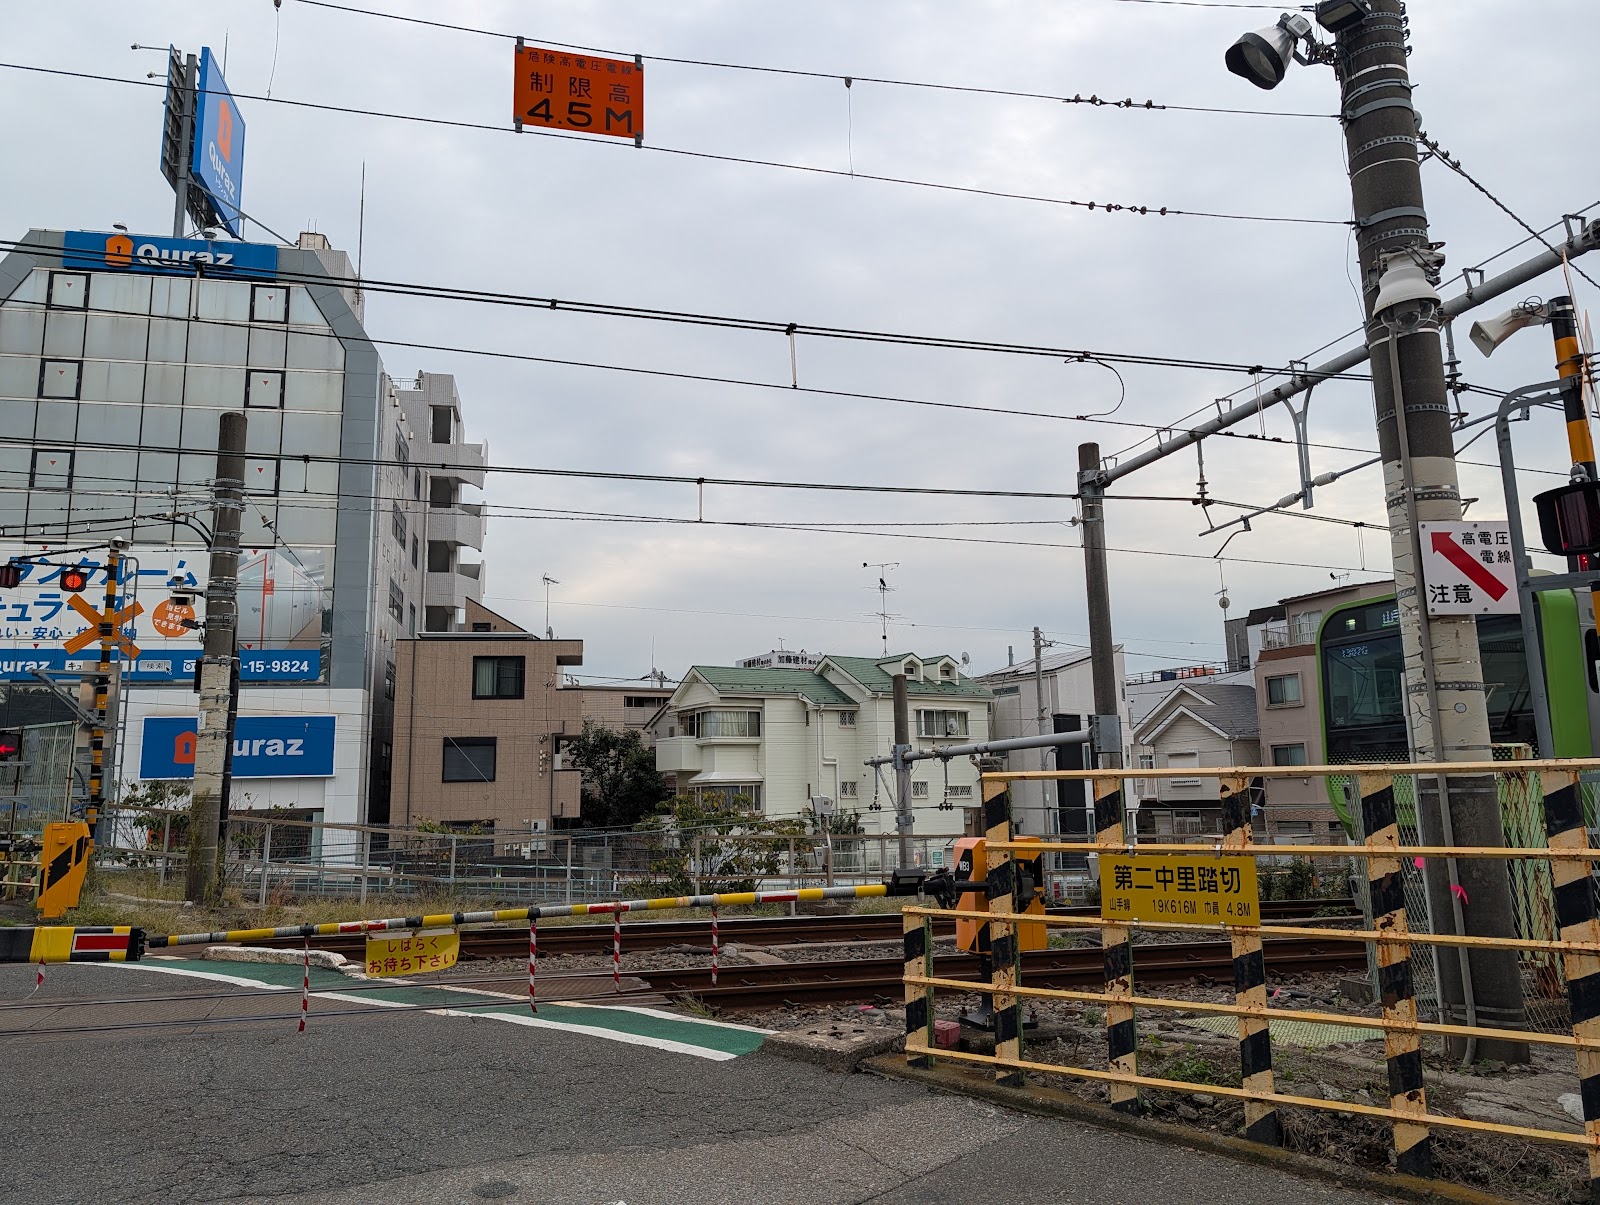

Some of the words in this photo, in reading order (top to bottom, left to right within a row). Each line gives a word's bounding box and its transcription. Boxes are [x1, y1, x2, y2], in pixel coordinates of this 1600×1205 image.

[528, 51, 632, 75] 危険高電圧電線
[530, 72, 630, 104] 制限高
[208, 141, 235, 200] Quraz
[136, 244, 234, 267] Quraz
[1461, 532, 1509, 546] 高電圧
[1480, 550, 1512, 564] 電線
[1429, 584, 1473, 604] 注意
[0, 660, 50, 675] uraz
[240, 660, 309, 673] -15-9824
[1114, 865, 1241, 894] 第二中里踏切
[1109, 898, 1131, 912] 山手線
[1152, 899, 1197, 914] 19K616M
[1226, 902, 1250, 917] 4.8M
[387, 937, 439, 953] しばらく
[369, 954, 455, 974] お待ち下さい
